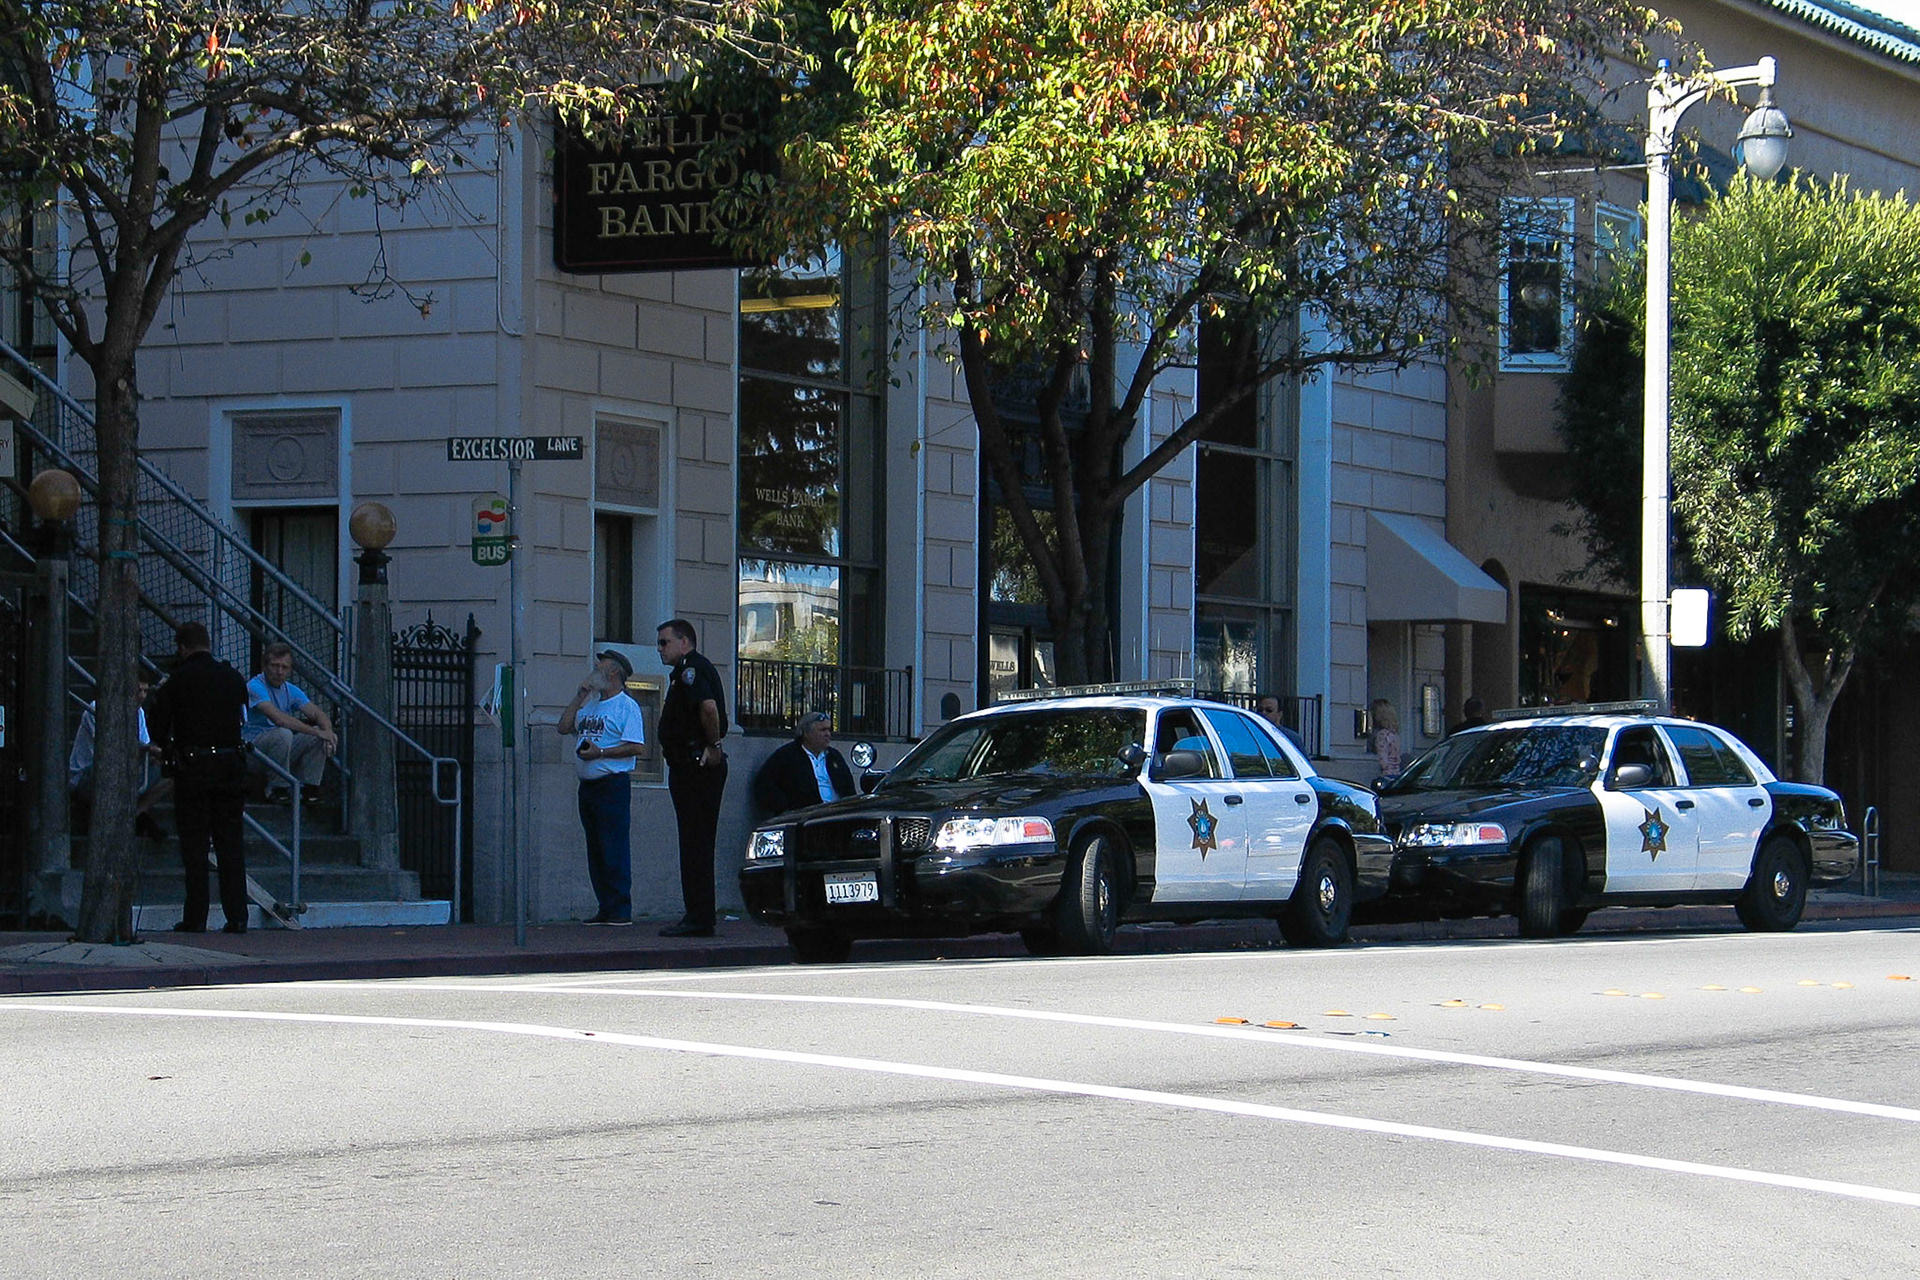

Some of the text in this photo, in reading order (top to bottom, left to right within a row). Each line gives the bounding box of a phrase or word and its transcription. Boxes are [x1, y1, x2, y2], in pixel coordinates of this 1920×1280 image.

[587, 158, 739, 195] FARGO
[598, 202, 730, 238] BANK
[451, 437, 578, 460] EXCELSIOR LANE
[755, 487, 825, 508] WELLS FARGO
[776, 513, 805, 528] BANK
[477, 546, 506, 561] BUS
[829, 883, 874, 900] 1113979
